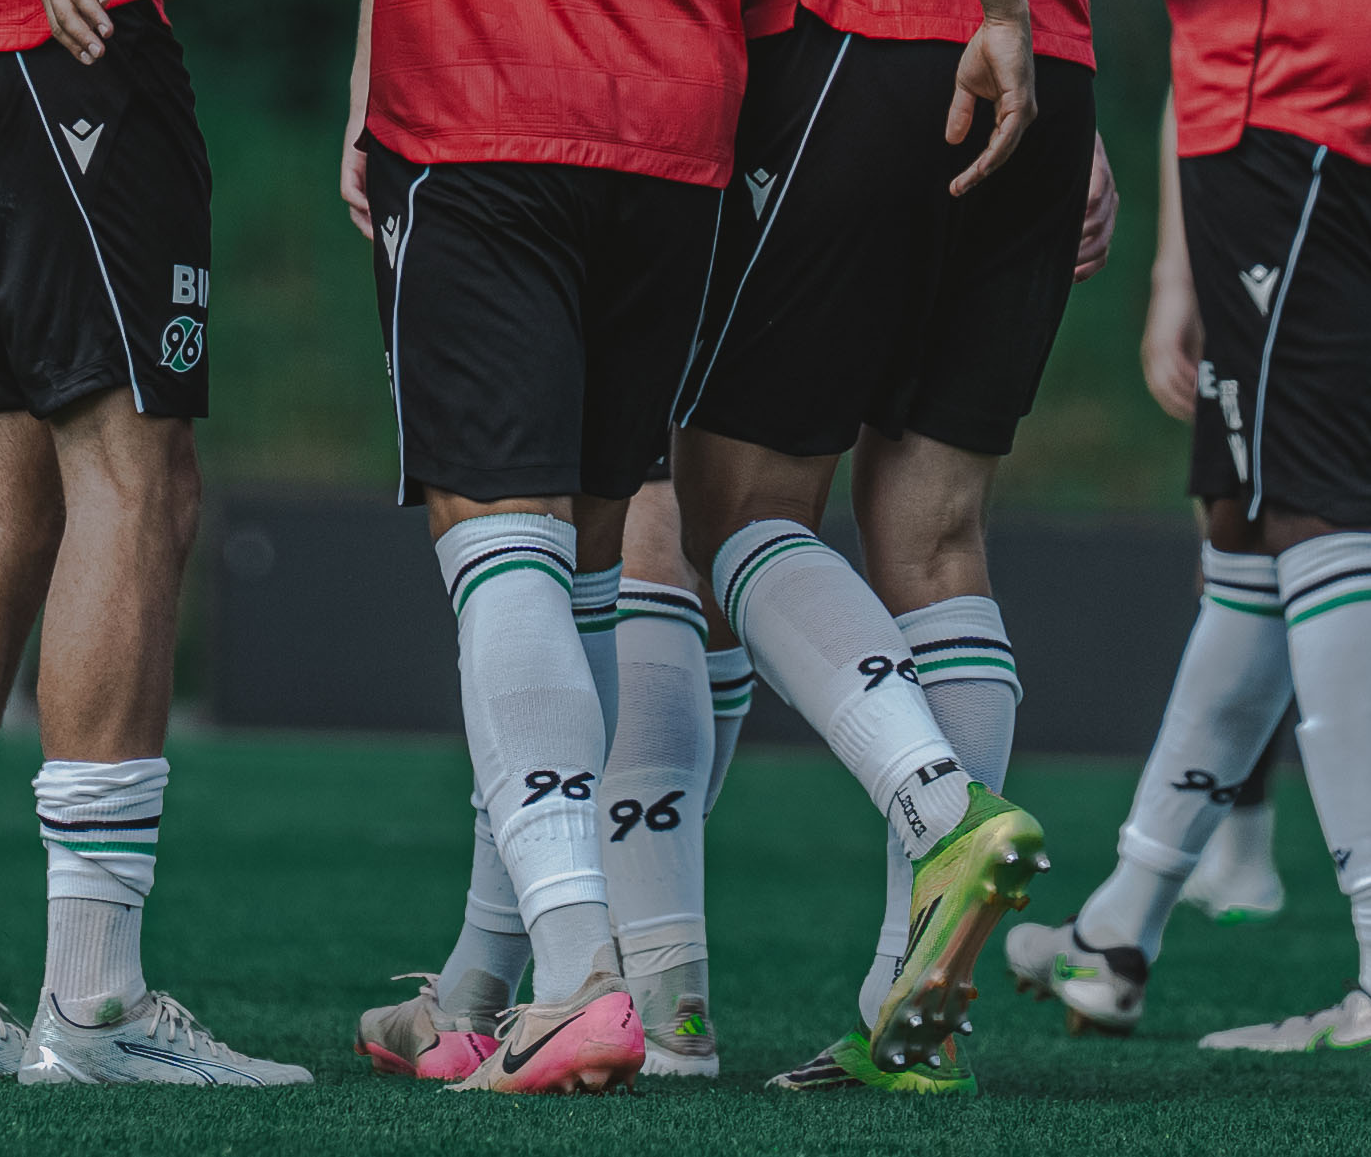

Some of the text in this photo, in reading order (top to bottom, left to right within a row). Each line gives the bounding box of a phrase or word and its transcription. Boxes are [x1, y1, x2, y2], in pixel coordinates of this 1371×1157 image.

[160, 317, 203, 371] 96
[858, 655, 921, 692] 96
[522, 770, 595, 807] 96
[609, 790, 686, 843] 96
